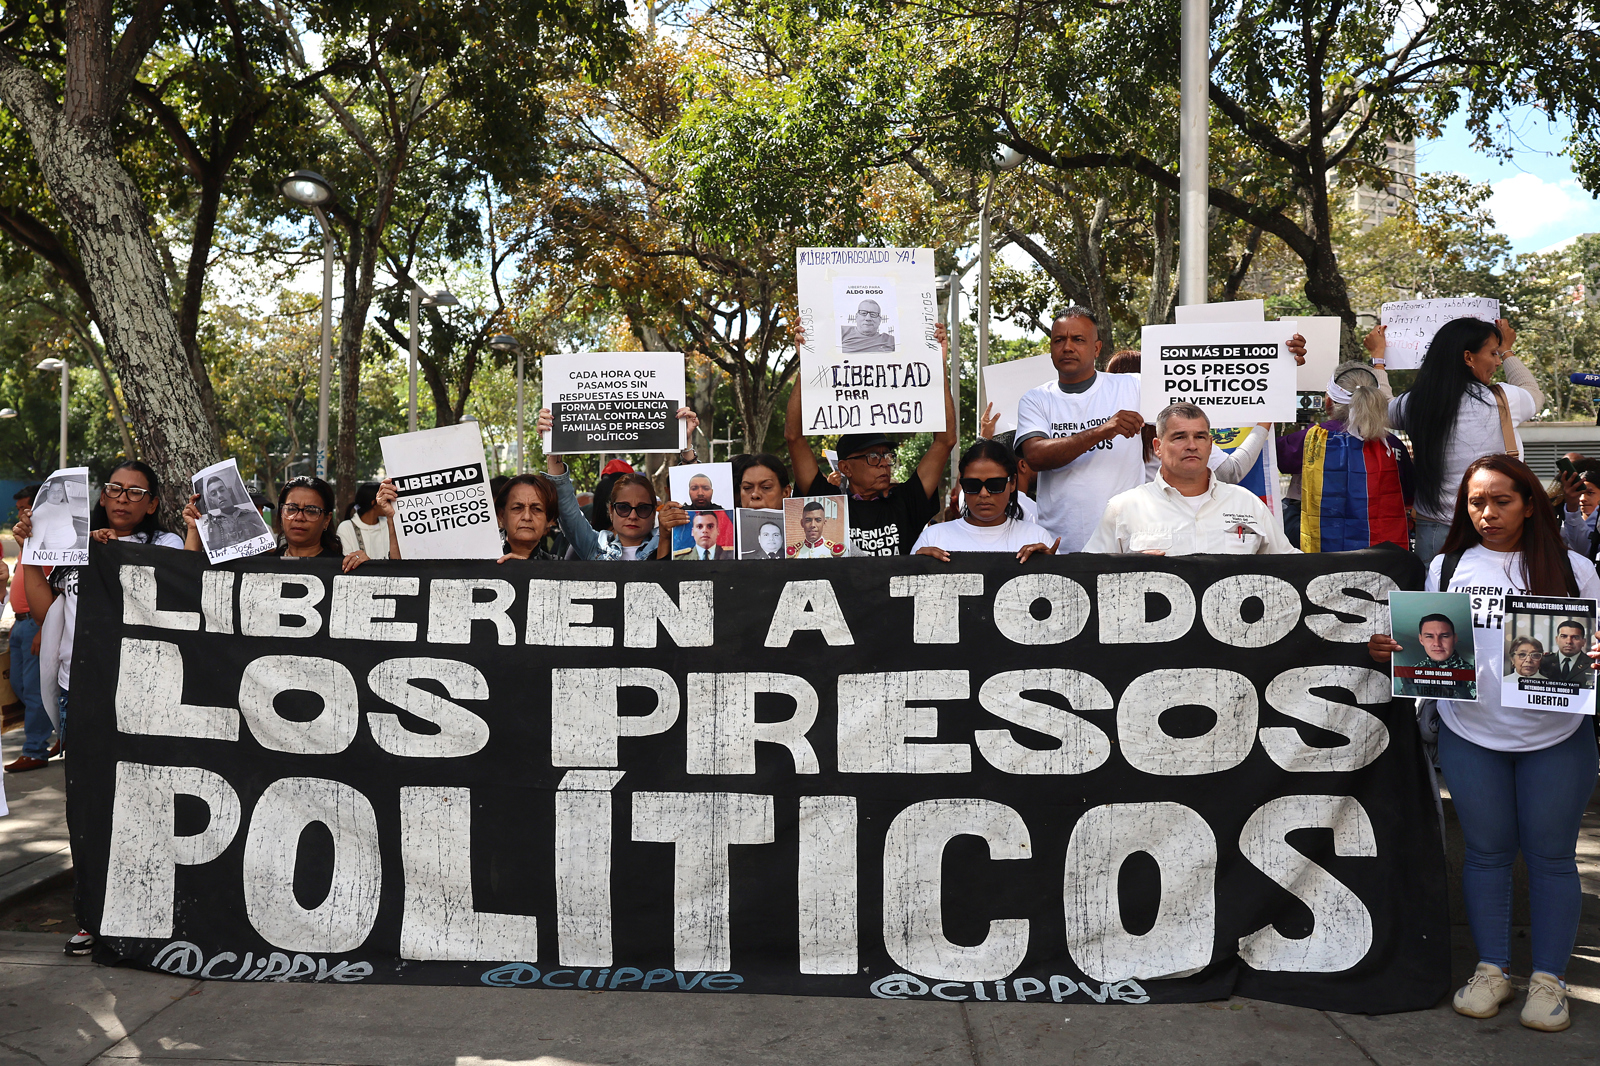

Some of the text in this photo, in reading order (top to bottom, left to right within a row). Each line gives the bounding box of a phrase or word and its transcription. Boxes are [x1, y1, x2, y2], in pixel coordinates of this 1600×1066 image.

[896, 248, 916, 265] YA!
[1162, 346, 1276, 357] SON MÁS DE 1.000
[569, 370, 656, 379] CADA HORA QUE
[1164, 363, 1270, 375] LOS PRESOS
[577, 380, 648, 389] PASAMOS SIN
[1165, 375, 1268, 392] POLÍTICOS
[560, 391, 665, 401] RESPUESTAS ES UNA
[835, 390, 869, 401] PARA
[1190, 396, 1265, 405] VENEZUELA
[561, 402, 668, 411] FORMA DE VIOLENCIA
[560, 413, 601, 422] ESTATAL
[603, 412, 646, 420] CONTRA
[809, 401, 923, 430] ALDO ROSO
[562, 423, 606, 432] FAMILIAS
[625, 422, 665, 430] PRESOS
[587, 431, 639, 441] POLÍTICOS
[394, 467, 478, 492] LIBERTAD
[396, 486, 485, 510] PARA TODOS
[400, 499, 488, 523] LOS PRESOS
[403, 511, 490, 536] POLÍTICOS
[879, 523, 898, 535] LOS
[886, 533, 900, 546] DE
[119, 564, 1401, 648] LIBEREN A TODOS
[1526, 602, 1563, 610] MONASTERIOS
[1565, 604, 1589, 612] VANEGAS
[115, 637, 1390, 775] LOS PRESOS
[1528, 694, 1569, 707] LIBERTAD
[100, 761, 1378, 982] POLÍTICOS
